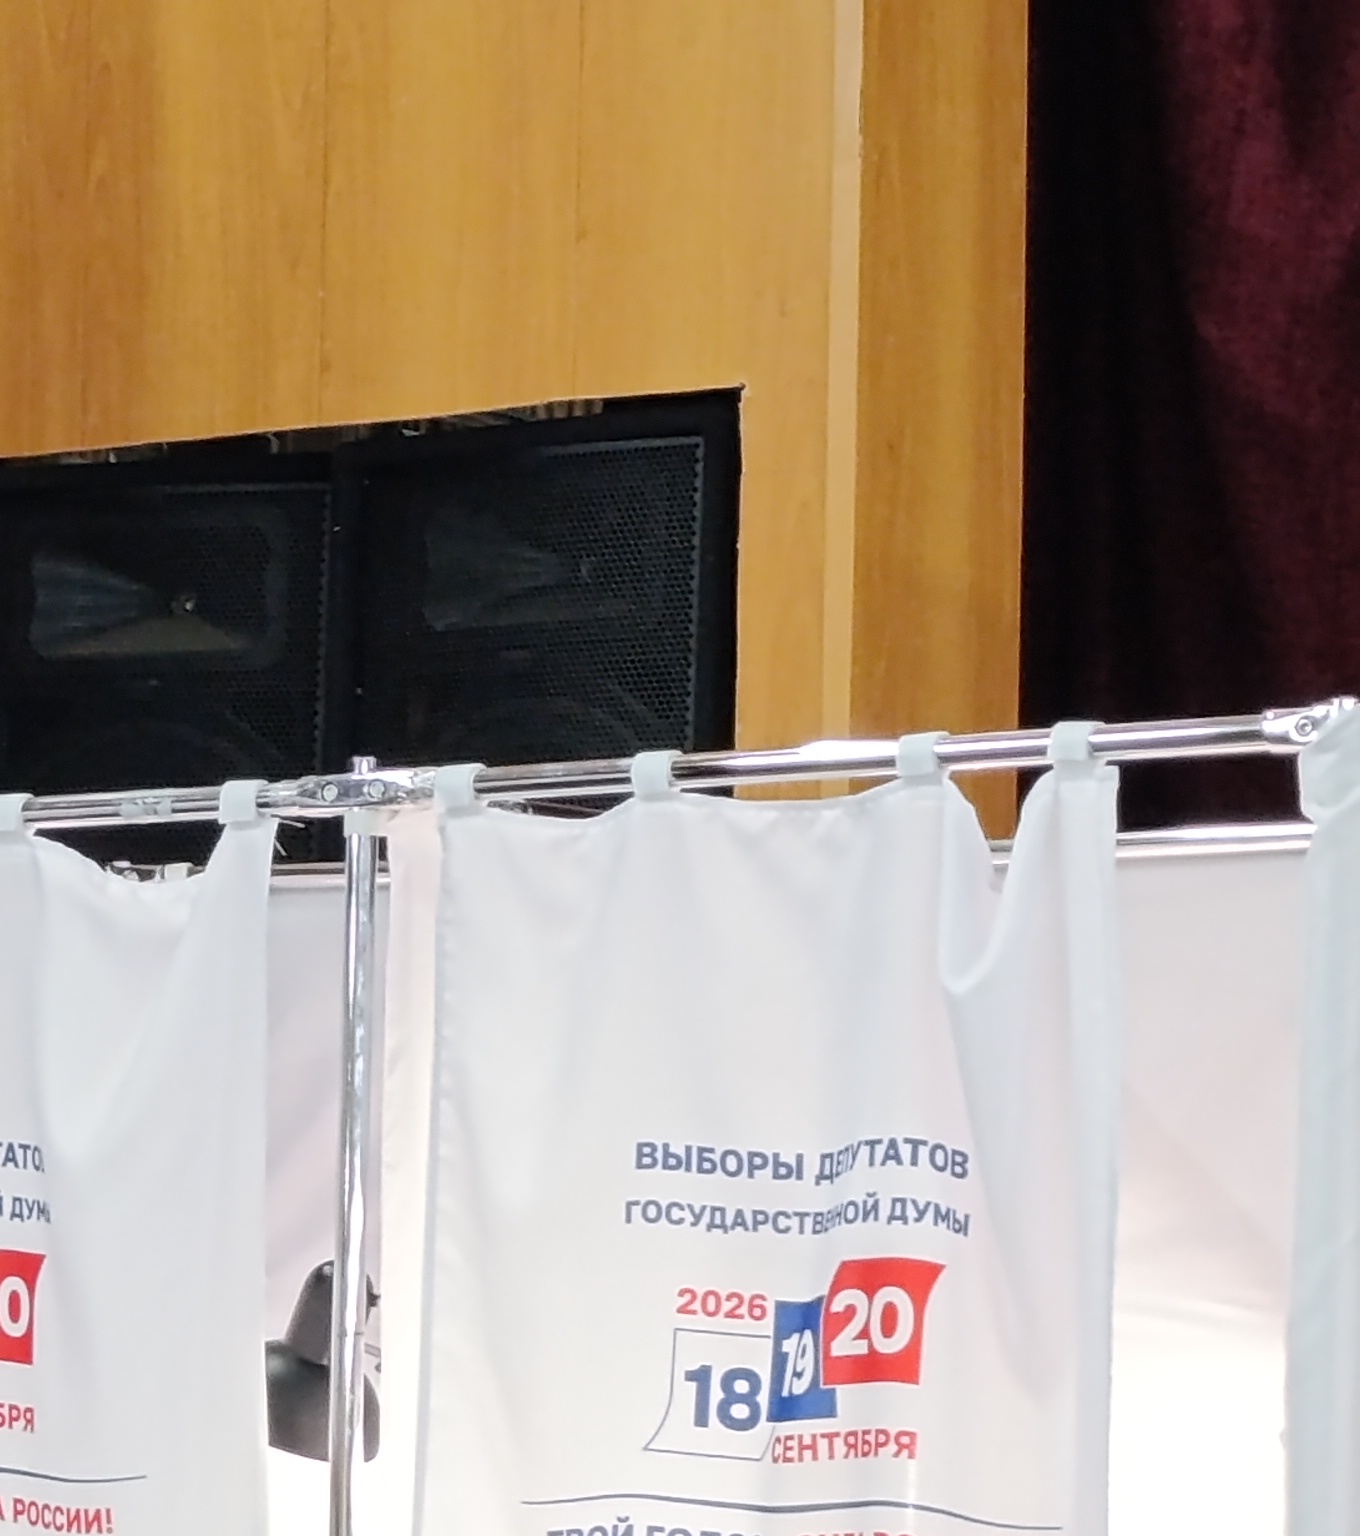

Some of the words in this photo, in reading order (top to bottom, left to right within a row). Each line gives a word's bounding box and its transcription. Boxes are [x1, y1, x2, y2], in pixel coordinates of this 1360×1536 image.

[634, 1140, 805, 1182] ВЫБОРЫ
[814, 1136, 970, 1186] ДЕПУТАТОВ
[9, 1195, 52, 1224] ДУМ
[885, 1196, 971, 1238] ДУМЫ
[675, 1287, 768, 1321] 2026
[828, 1284, 915, 1358] 20
[780, 1329, 815, 1398] 19
[683, 1363, 763, 1432] 18
[771, 1427, 918, 1464] СЕНТЯБРЯ
[11, 1496, 114, 1535] РОССИИ!
